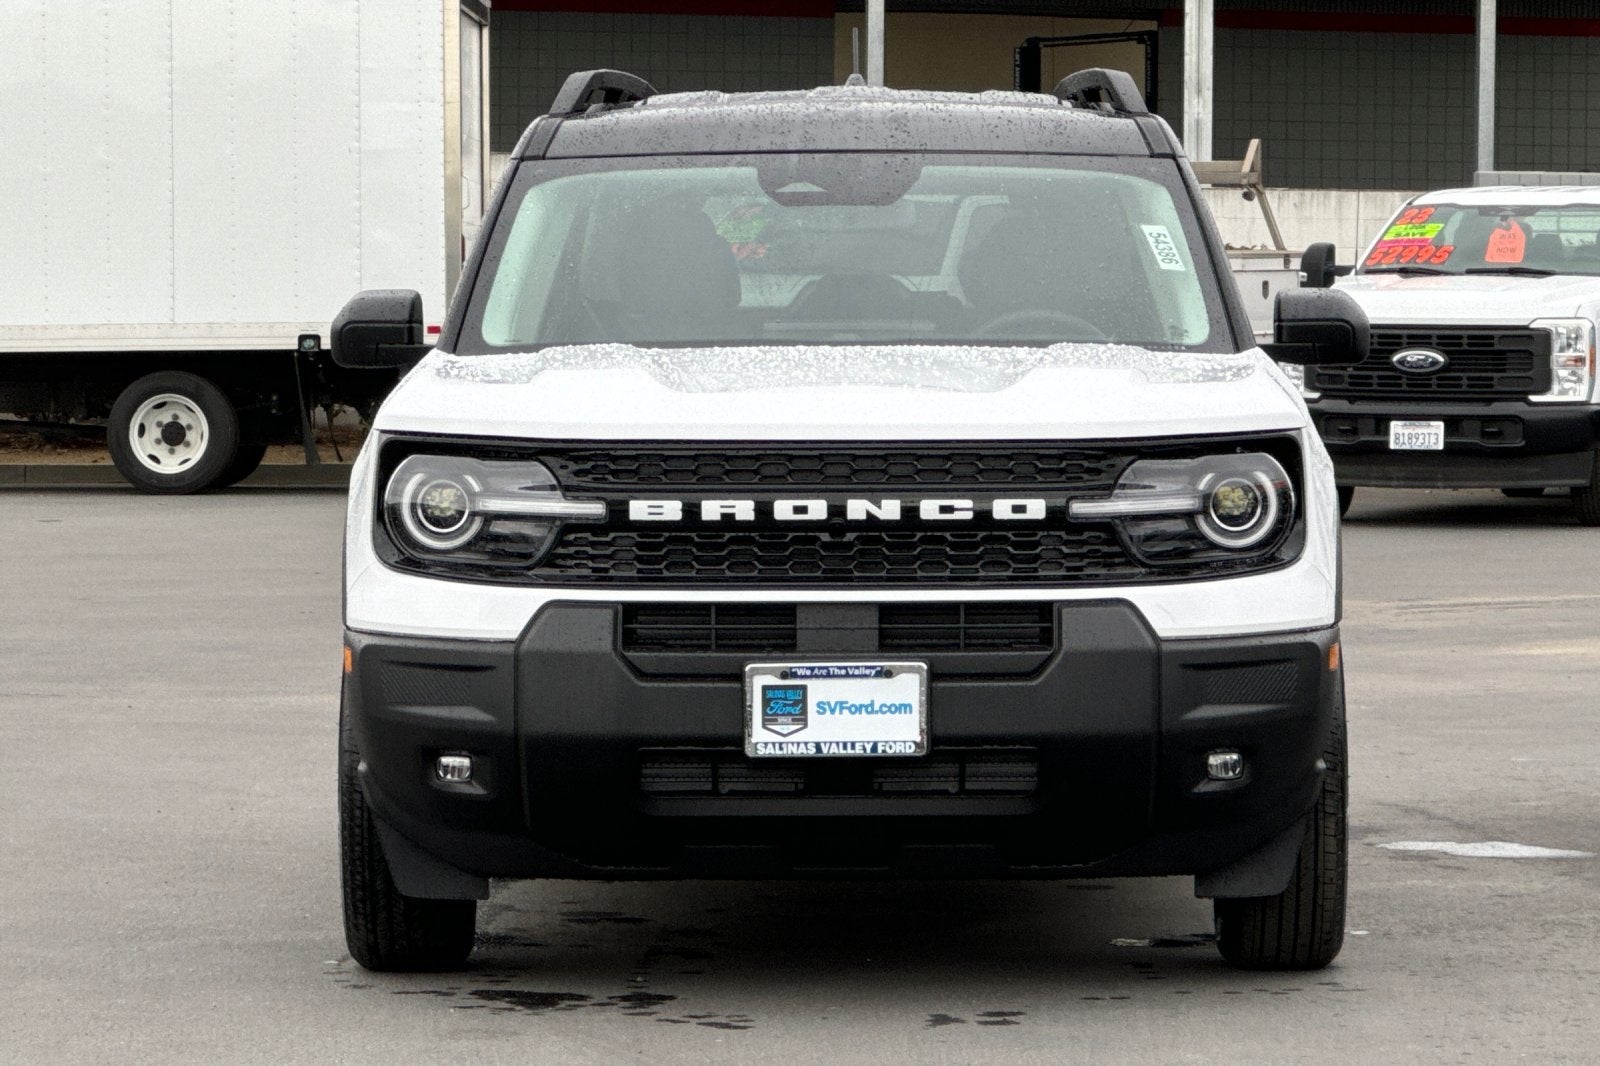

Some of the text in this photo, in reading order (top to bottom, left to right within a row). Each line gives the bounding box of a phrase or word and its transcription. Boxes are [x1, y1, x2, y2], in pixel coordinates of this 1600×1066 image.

[1396, 207, 1435, 225] 23
[1148, 232, 1179, 265] 54386
[1366, 245, 1455, 265] 52995
[1404, 354, 1433, 368] Ford
[629, 498, 1046, 521] BRONCO
[812, 667, 828, 676] Are
[828, 667, 847, 676] The
[766, 700, 803, 715] Ford
[816, 699, 913, 716] SVFord.com
[756, 742, 916, 755] SALINAS VALLEY FORD
